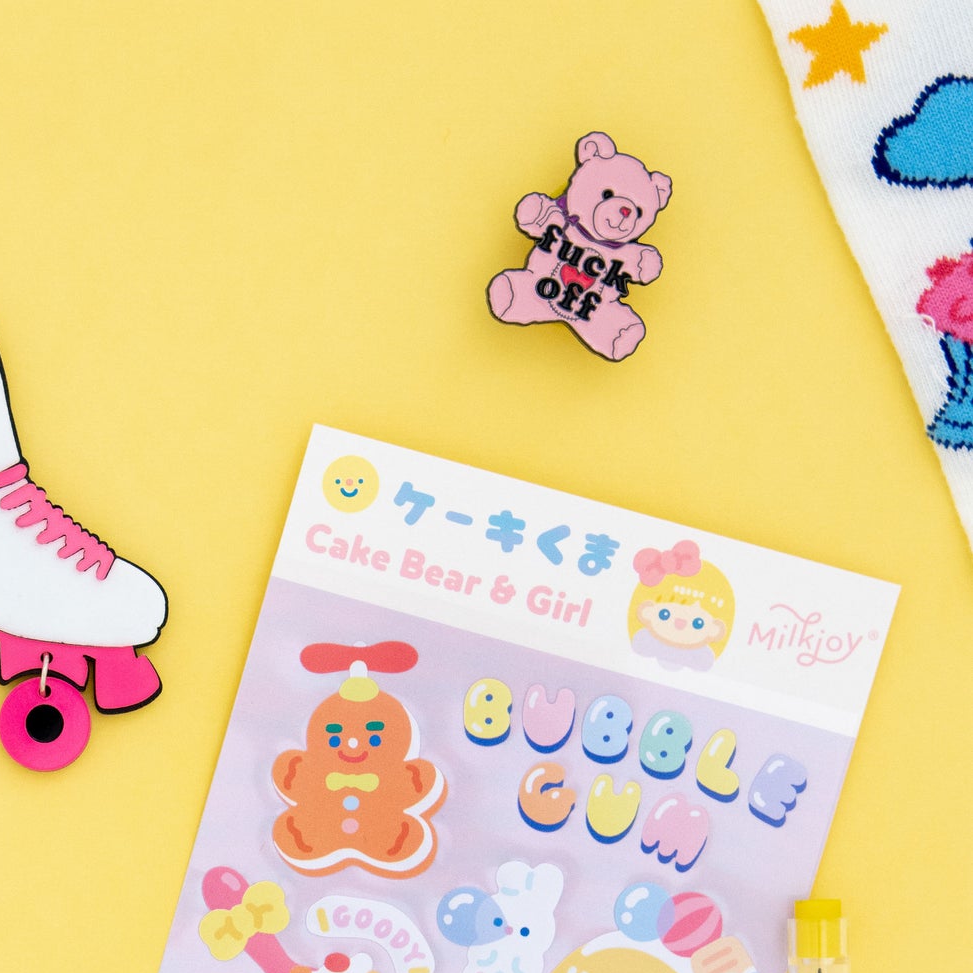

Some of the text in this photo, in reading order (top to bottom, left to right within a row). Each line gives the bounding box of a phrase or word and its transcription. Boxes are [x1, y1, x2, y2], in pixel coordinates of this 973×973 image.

[536, 277, 602, 322] off
[537, 224, 633, 298] fuck
[305, 523, 593, 628] Cake Bear & Girl
[393, 481, 620, 576] ケーキくま
[463, 678, 808, 829] BUBBLE
[517, 761, 711, 873] GUM
[332, 904, 427, 964] GOODY
